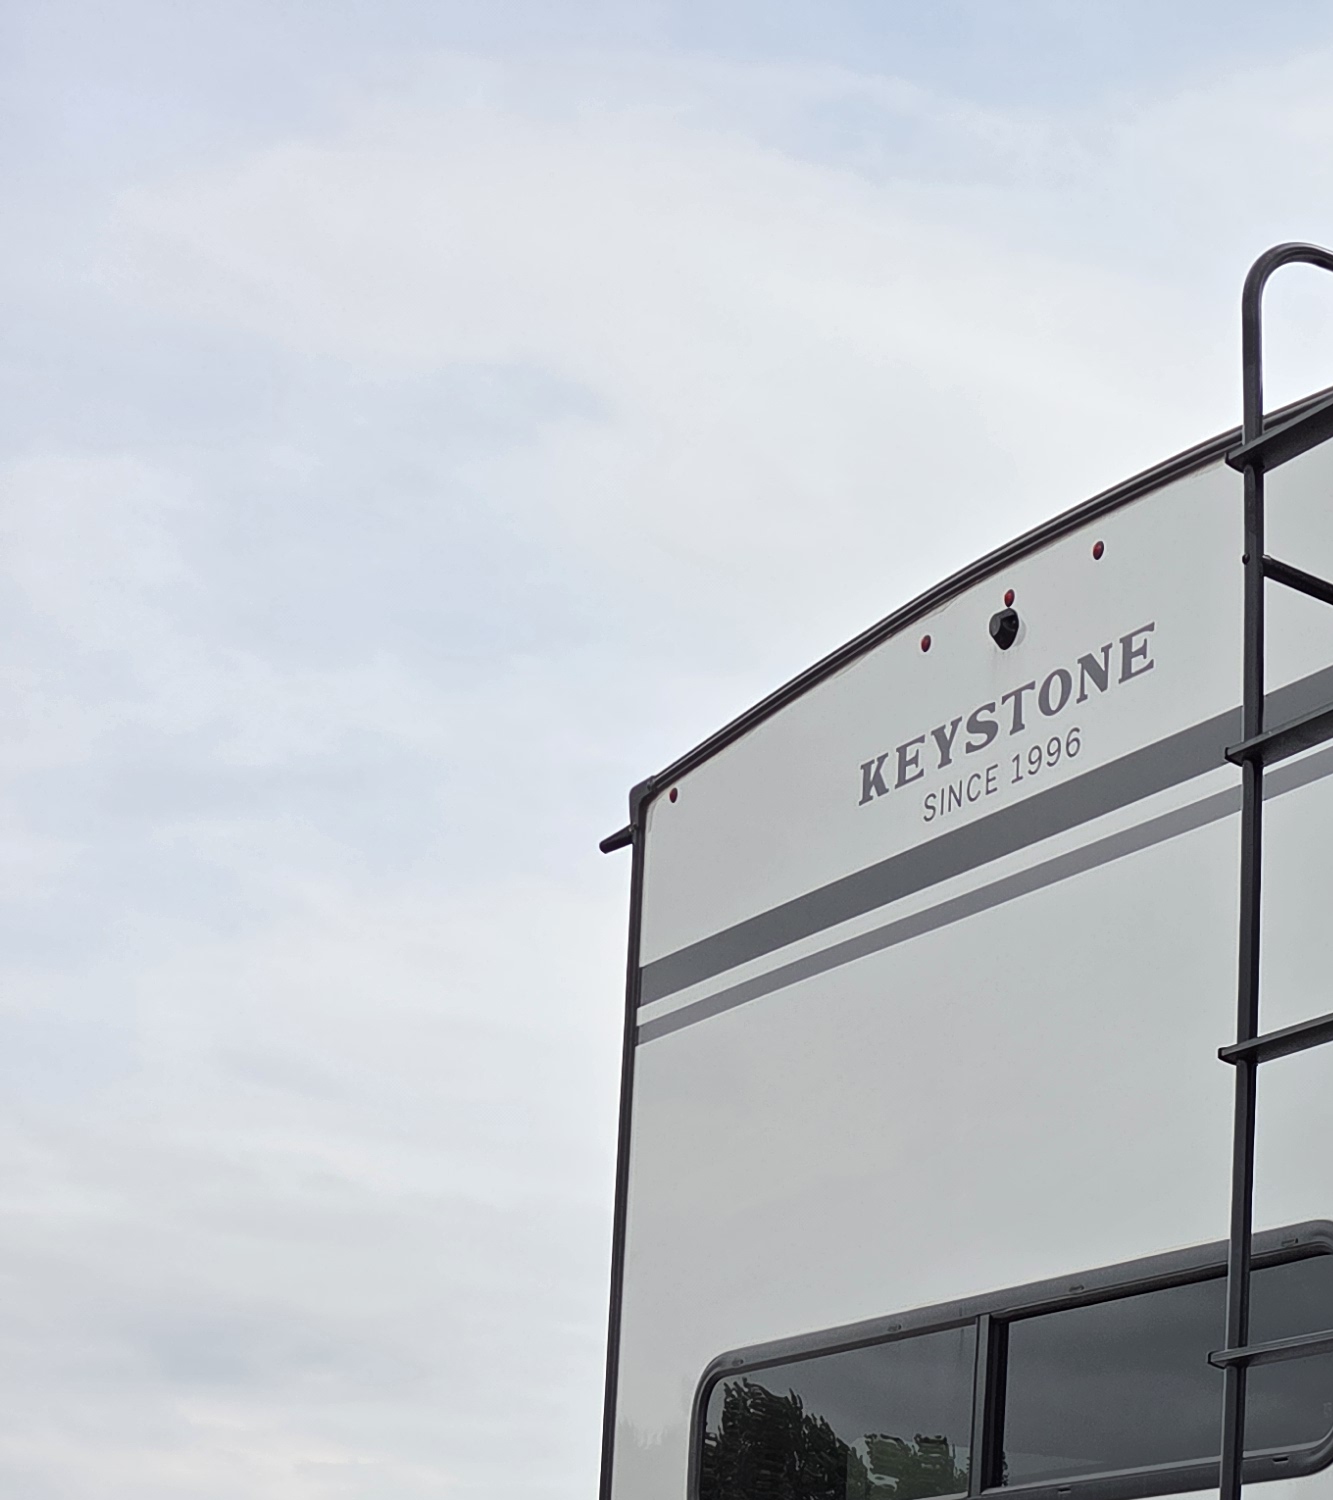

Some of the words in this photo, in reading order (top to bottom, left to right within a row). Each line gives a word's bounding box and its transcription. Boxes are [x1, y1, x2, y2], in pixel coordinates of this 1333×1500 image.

[858, 621, 1156, 807] KEYSTONE
[922, 764, 999, 823] SINCE
[1010, 727, 1082, 785] 1996
